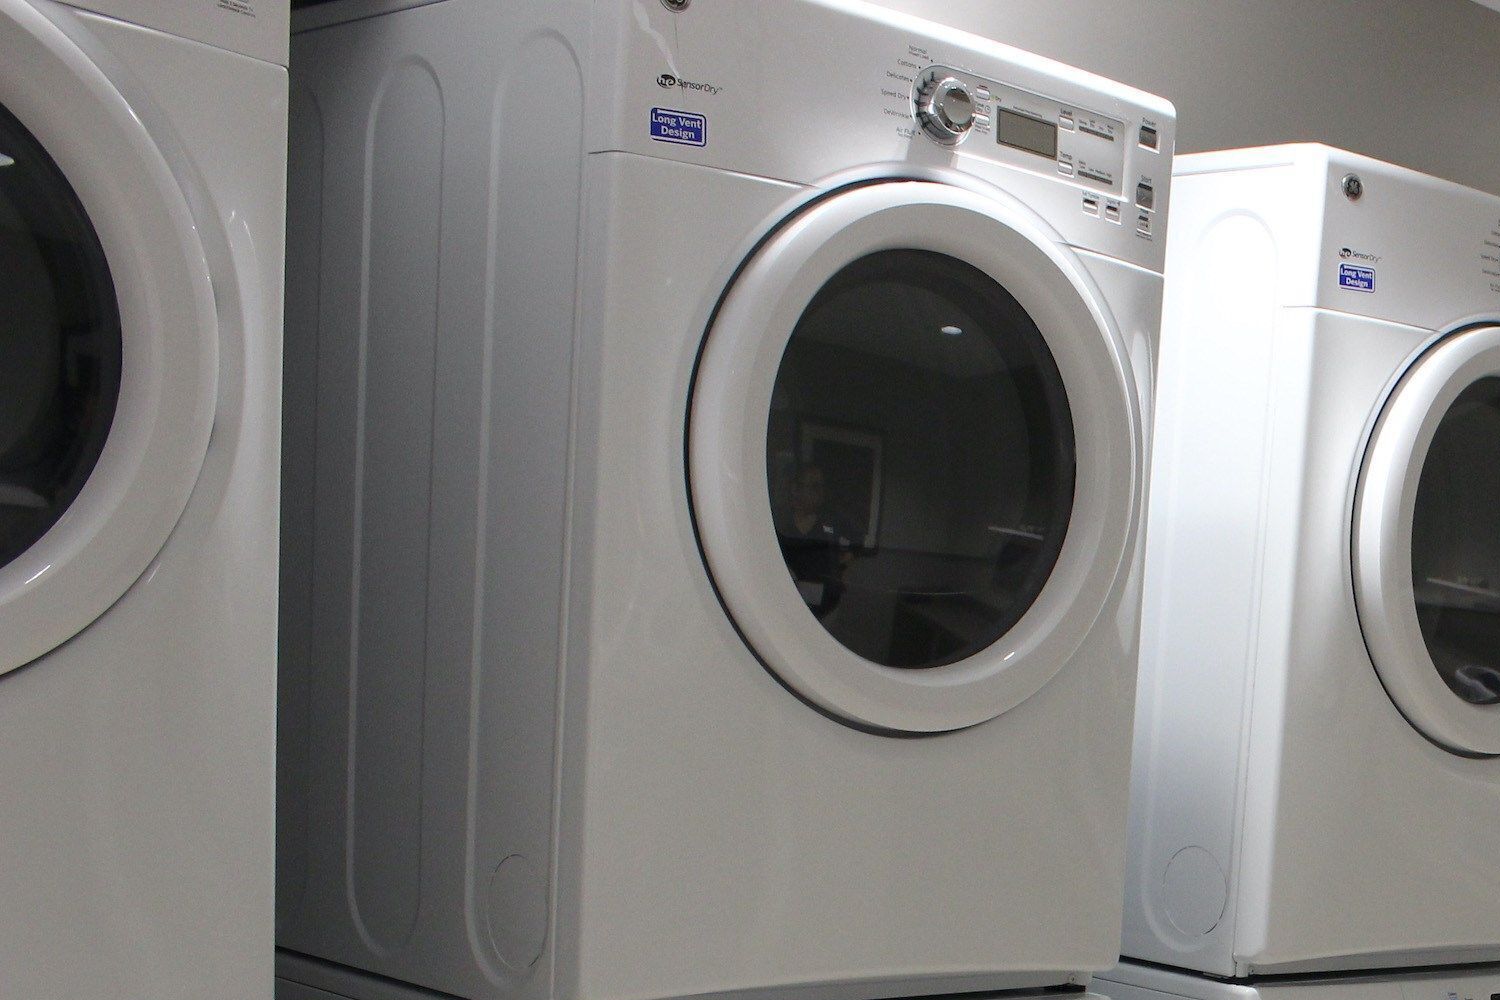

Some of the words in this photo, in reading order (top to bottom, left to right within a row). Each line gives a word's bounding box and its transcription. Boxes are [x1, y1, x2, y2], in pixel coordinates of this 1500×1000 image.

[652, 112, 676, 127] Long
[679, 116, 702, 129] Vent
[661, 125, 695, 140] Design
[1341, 266, 1357, 278] Long
[1357, 270, 1372, 279] Vent
[1345, 276, 1369, 288] Design
